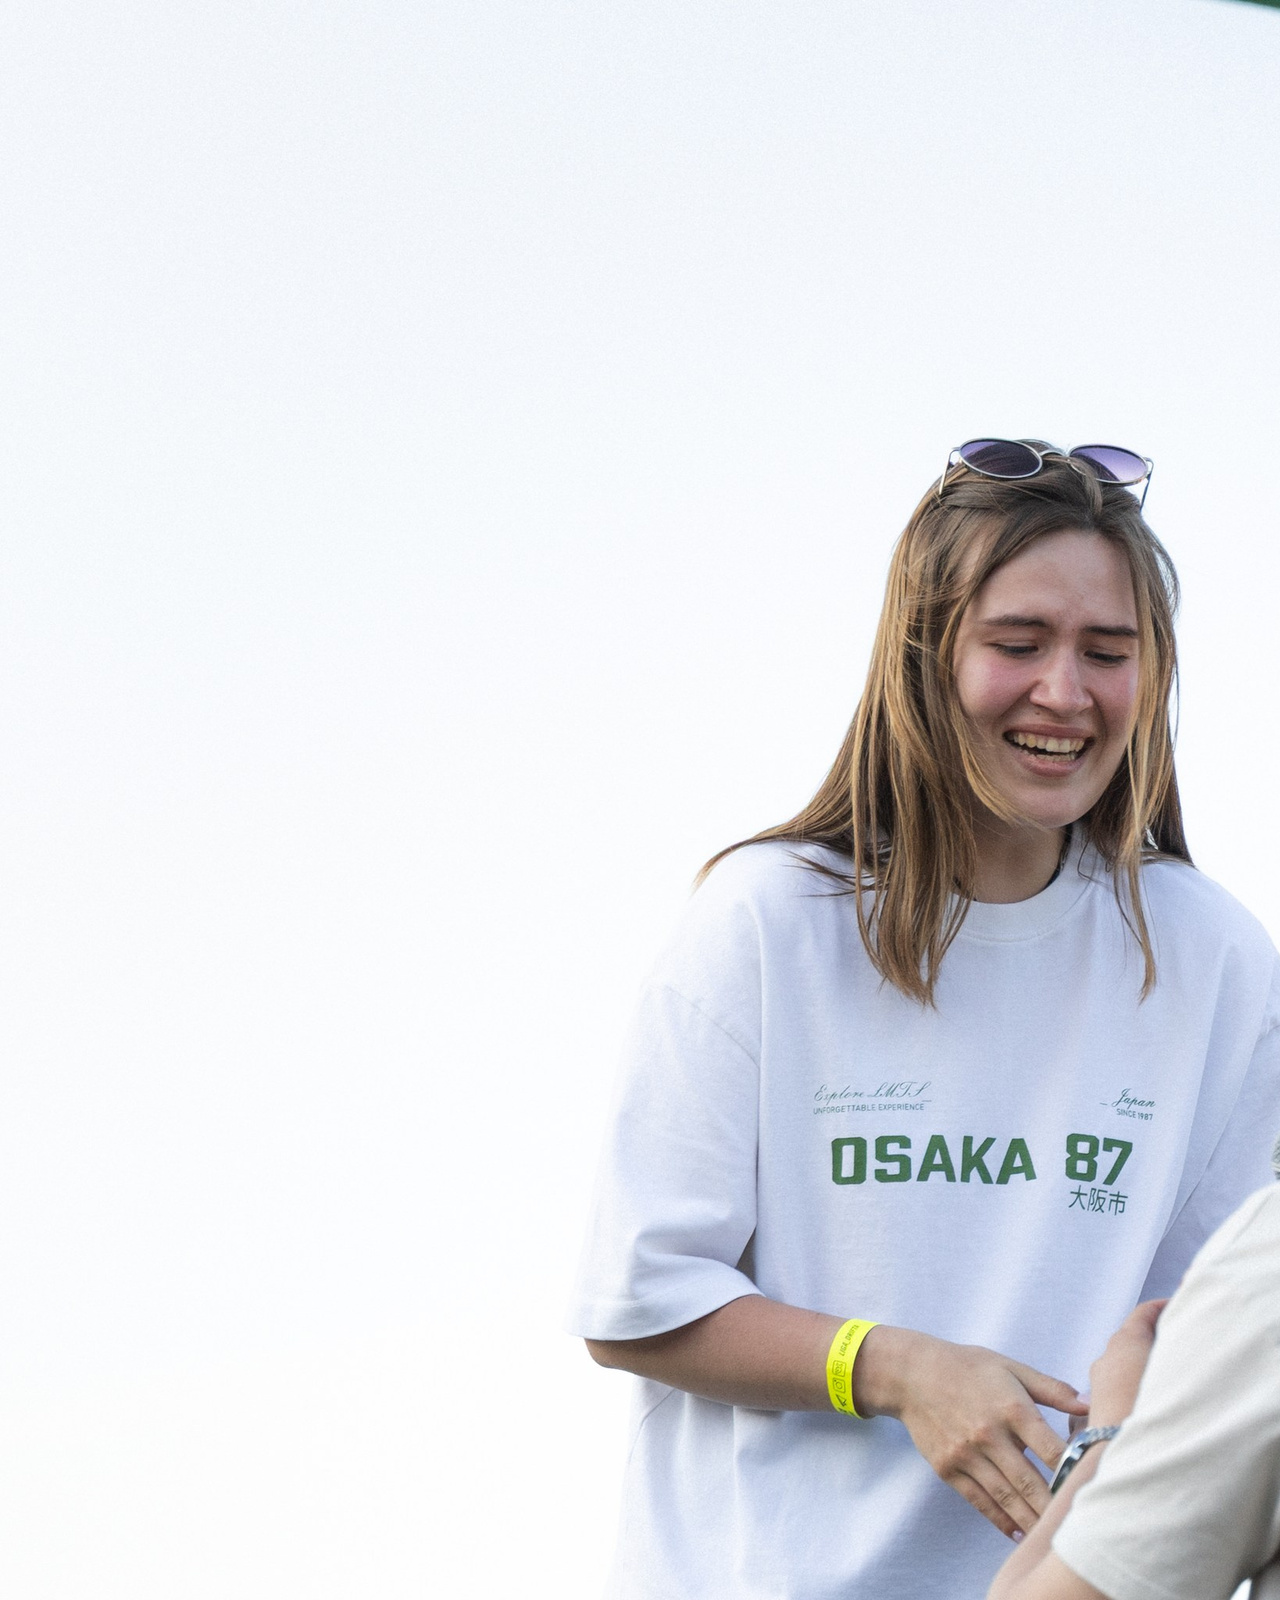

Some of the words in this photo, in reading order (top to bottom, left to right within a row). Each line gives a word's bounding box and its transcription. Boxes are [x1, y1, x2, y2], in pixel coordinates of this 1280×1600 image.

[814, 1084, 864, 1106] Explore
[1111, 1088, 1156, 1110] Japan
[813, 1104, 876, 1115] UNFORGETTABLE
[878, 1103, 925, 1112] EXPERIENCE
[1116, 1108, 1136, 1119] SINCE
[1137, 1112, 1153, 1121] 1987
[831, 1134, 1037, 1185] OSAKA
[1065, 1132, 1134, 1185] 87
[1068, 1184, 1129, 1215] 大阪市
